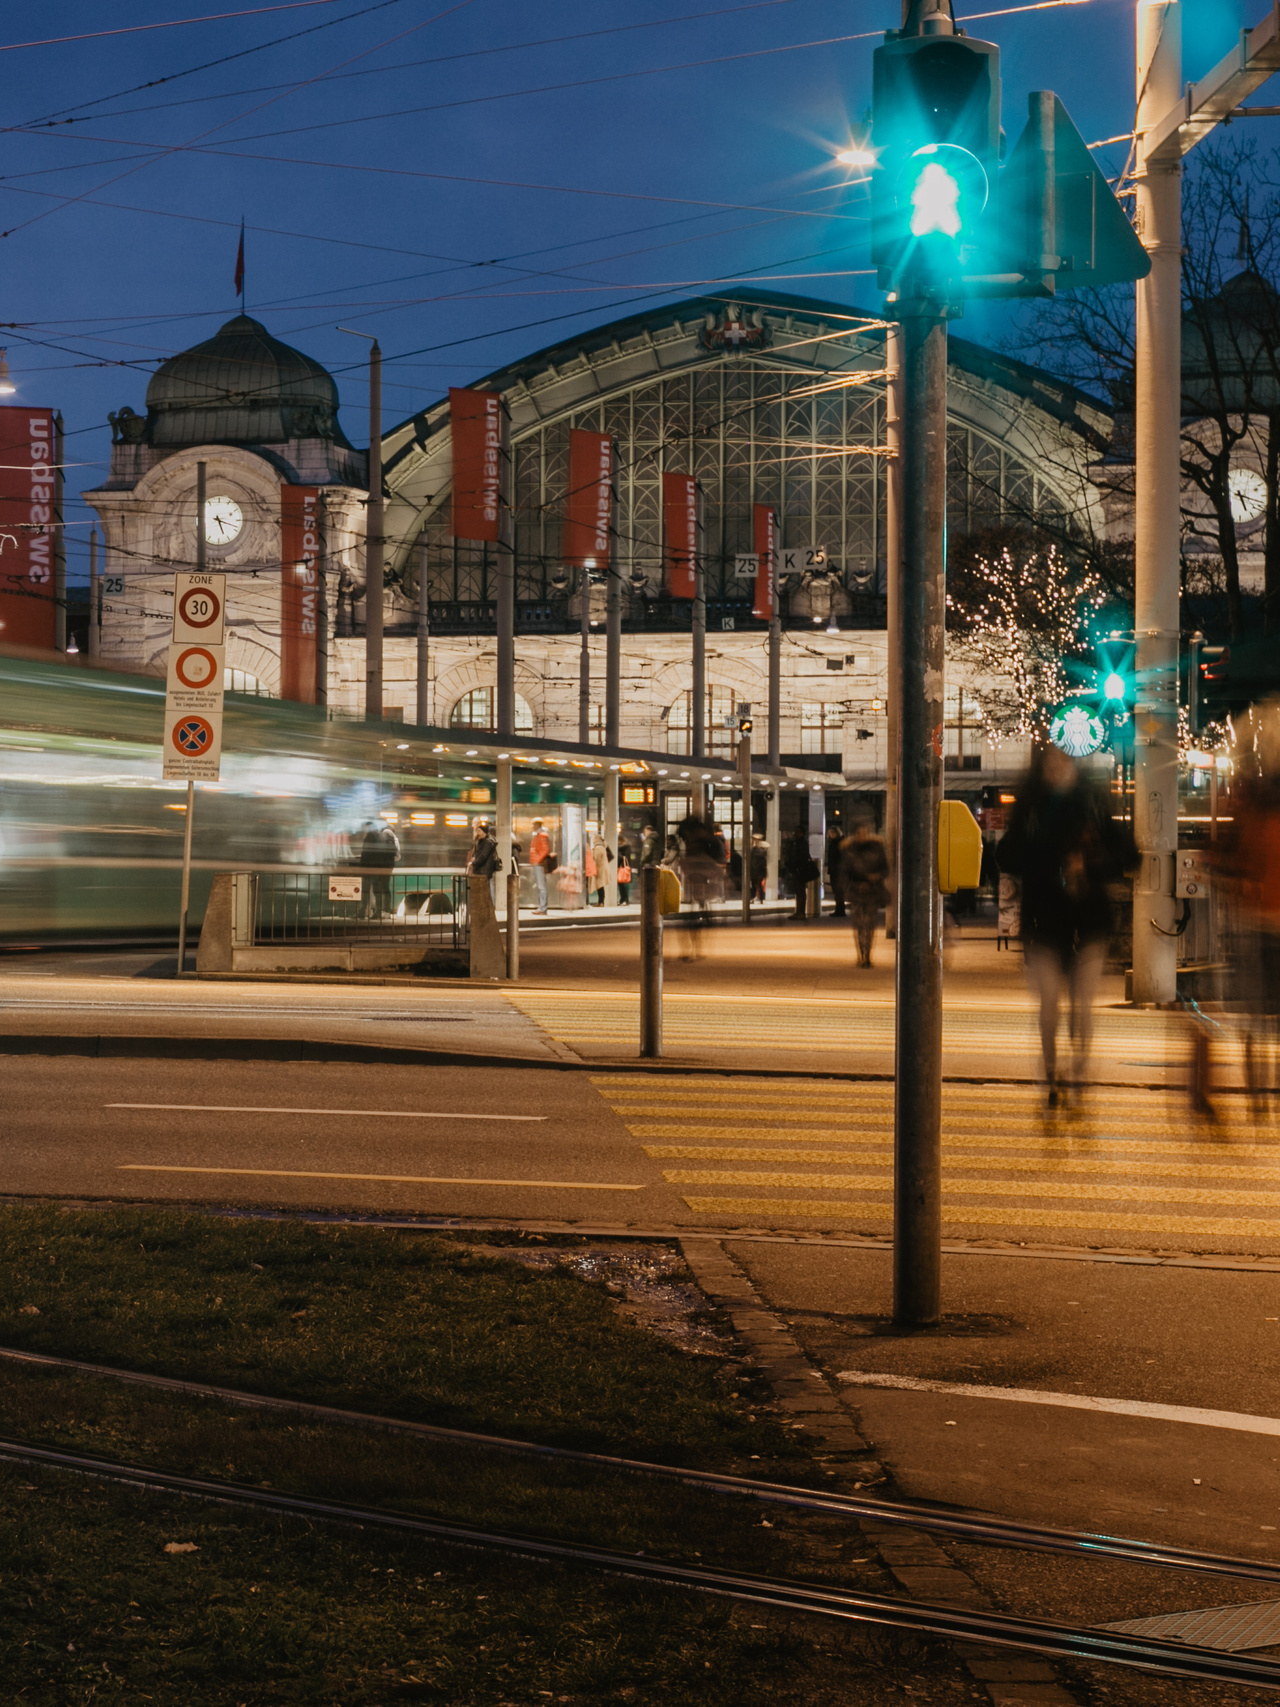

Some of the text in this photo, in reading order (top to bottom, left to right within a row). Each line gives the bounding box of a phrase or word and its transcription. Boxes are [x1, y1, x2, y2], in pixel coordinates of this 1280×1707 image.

[785, 553, 796, 569] K
[806, 550, 825, 566] 25
[738, 559, 756, 573] 25
[106, 578, 123, 593] 25
[188, 575, 213, 585] ZONE
[190, 600, 208, 616] 30
[723, 619, 733, 629] K
[740, 704, 749, 714] 18
[726, 717, 735, 726] 15
